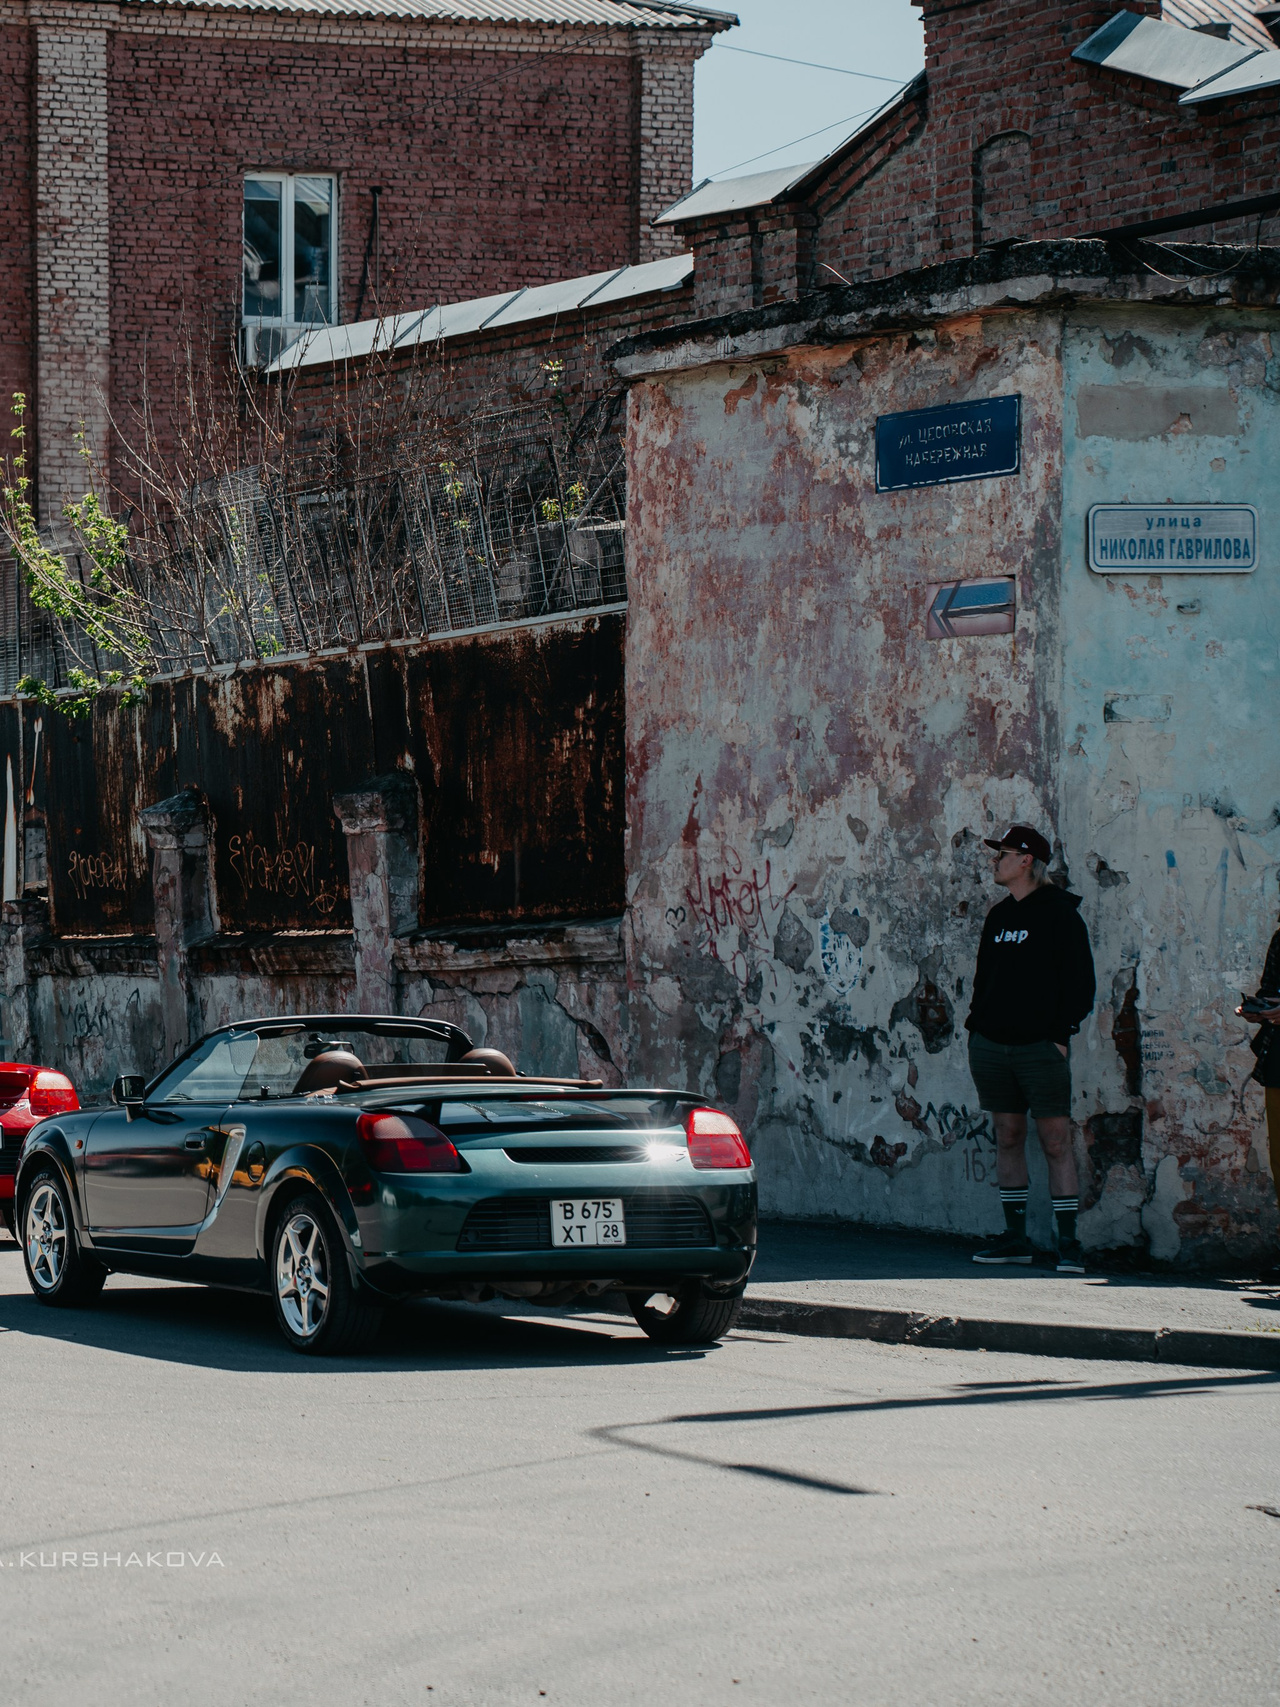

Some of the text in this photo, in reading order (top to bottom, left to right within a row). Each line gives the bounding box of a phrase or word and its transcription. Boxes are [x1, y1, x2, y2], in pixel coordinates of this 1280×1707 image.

[905, 442, 988, 467] НАБЕРЕЖНАЯ
[1145, 517, 1202, 531] улица
[1100, 537, 1251, 560] НИКОЛАЯ ГАВРИЛОВА
[994, 929, 1029, 944] Jeep
[581, 1201, 613, 1219] 675
[602, 1224, 619, 1238] 28
